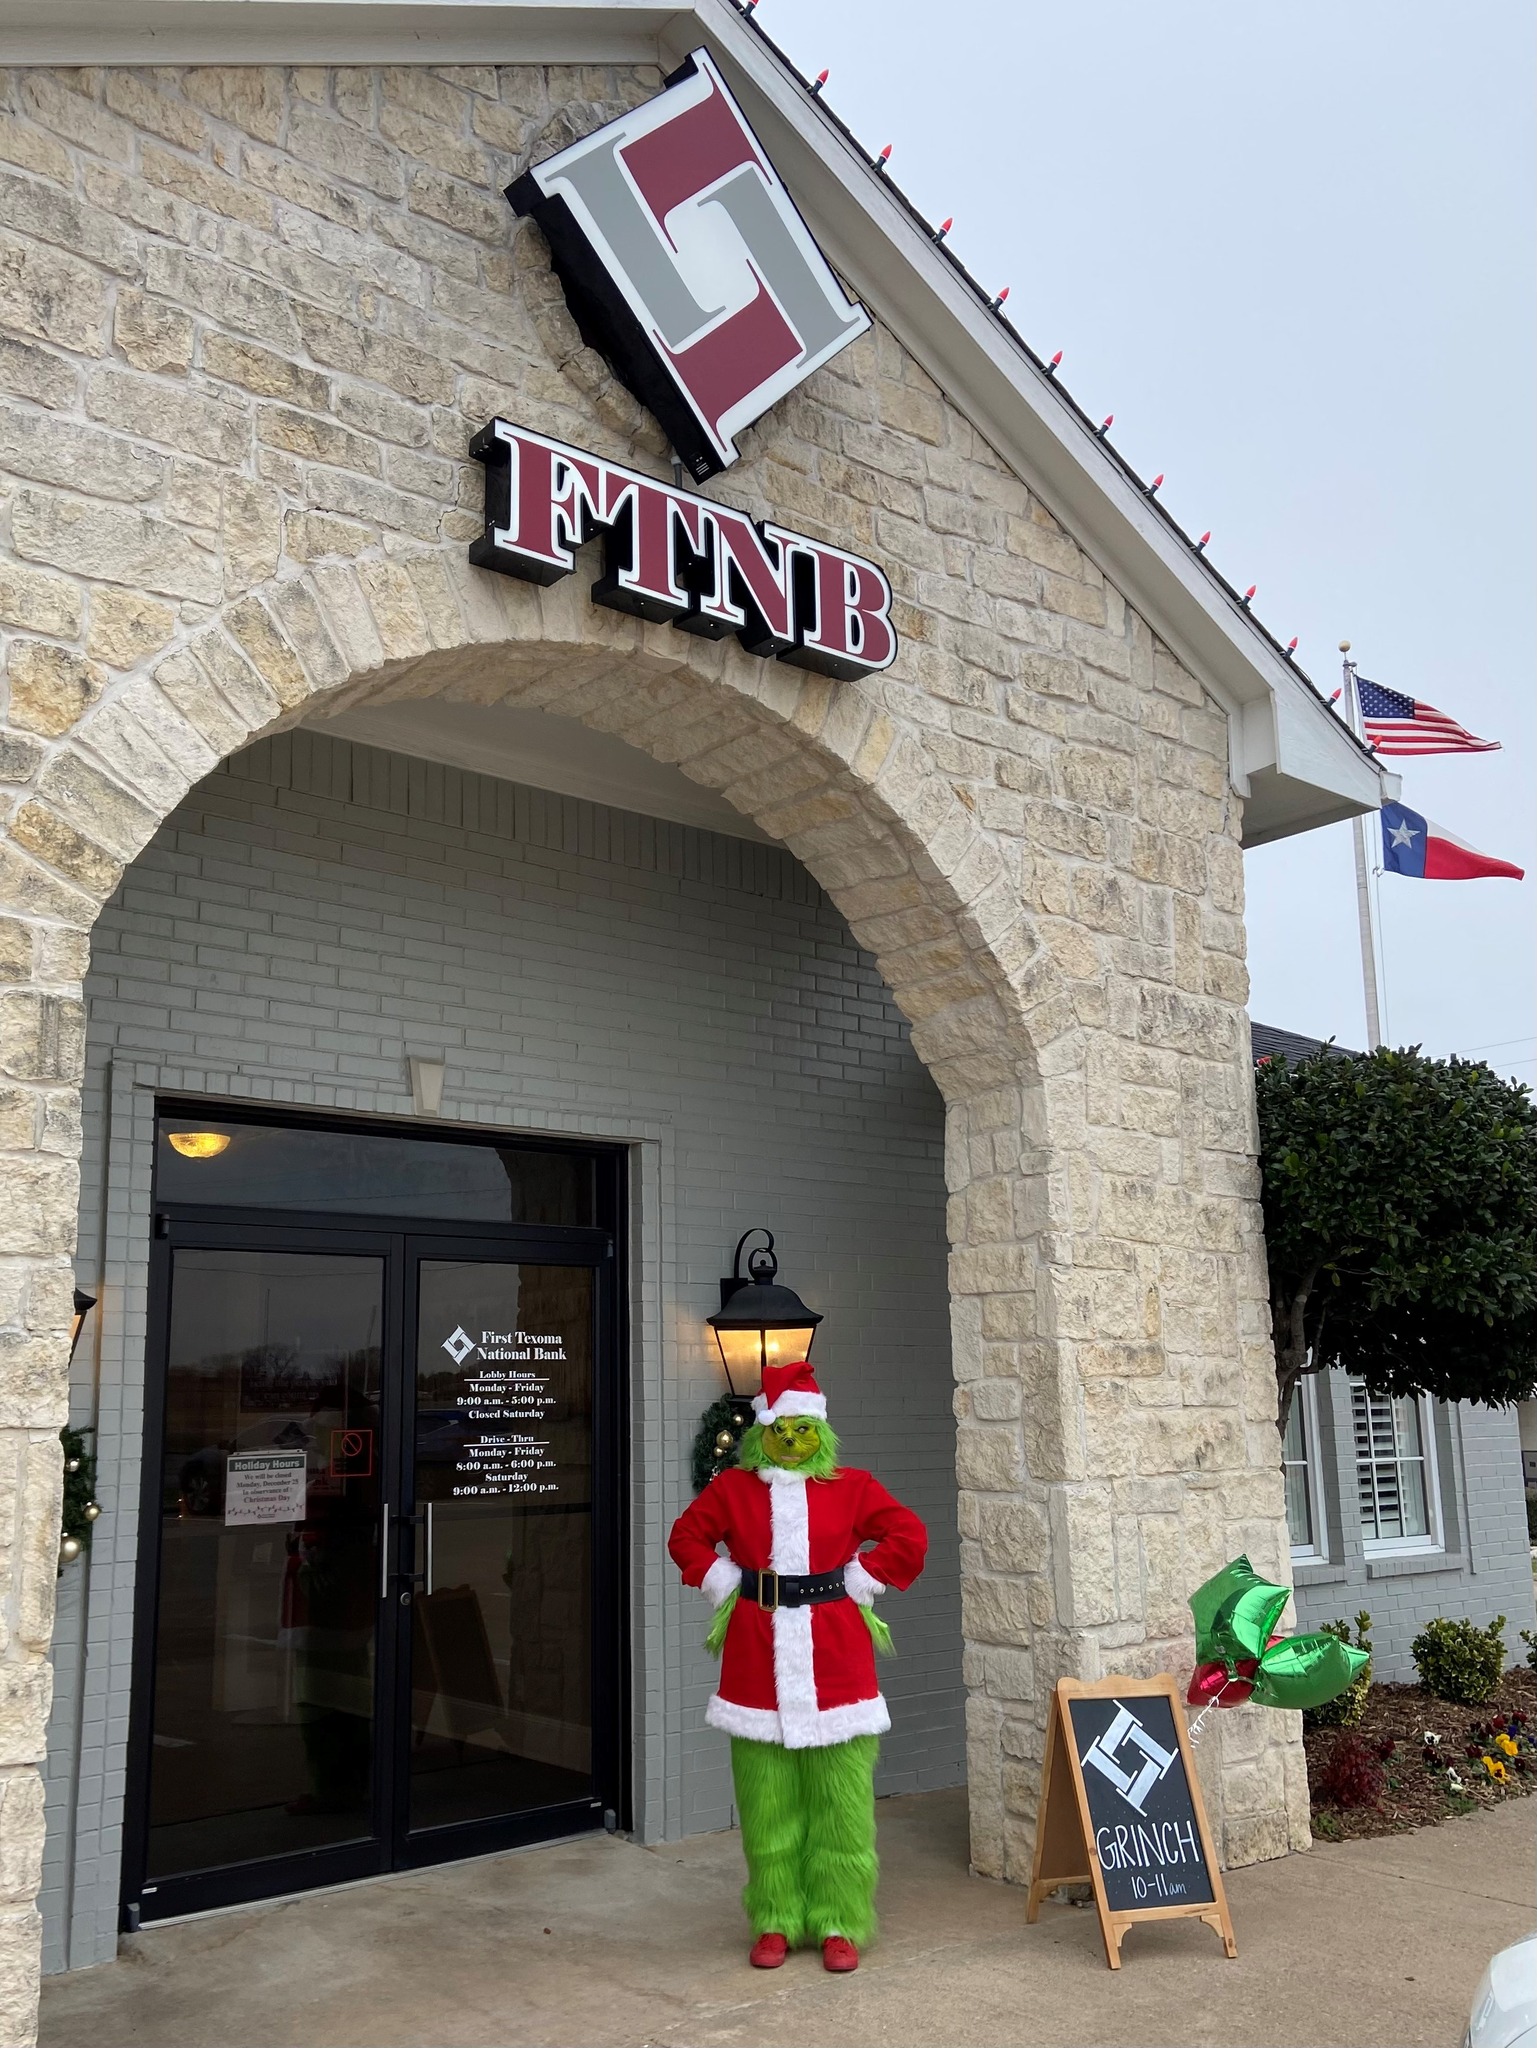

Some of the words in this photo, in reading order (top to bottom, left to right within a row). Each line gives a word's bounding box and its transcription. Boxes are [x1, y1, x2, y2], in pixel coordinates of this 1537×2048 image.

[494, 418, 898, 670] FTNB
[481, 1331, 512, 1344] First
[515, 1331, 562, 1344] Texoma
[476, 1348, 530, 1360] National
[534, 1348, 566, 1359] Bank
[480, 1370, 506, 1380] Lobby
[508, 1370, 536, 1378] Hours
[470, 1384, 507, 1393] Monday
[515, 1383, 544, 1393] Friday
[457, 1397, 481, 1405] 9:00
[511, 1396, 534, 1404] 5:00
[537, 1396, 556, 1406] p.m.
[468, 1410, 500, 1418] Closed
[503, 1410, 544, 1419] Saturday
[511, 1434, 534, 1442] Thru
[469, 1448, 506, 1458] Monday
[515, 1447, 544, 1456] Friday
[235, 1461, 270, 1470] Holiday
[272, 1460, 300, 1468] Hours
[456, 1462, 480, 1471] 8:00
[483, 1462, 503, 1470] a.m.
[510, 1460, 534, 1468] 6:00
[537, 1460, 556, 1469] p.m.
[485, 1472, 528, 1482] Saturday
[453, 1486, 478, 1496] 9:00
[508, 1483, 537, 1493] 12:00
[540, 1484, 558, 1493] p.m.
[1096, 1820, 1200, 1870] GRINCH
